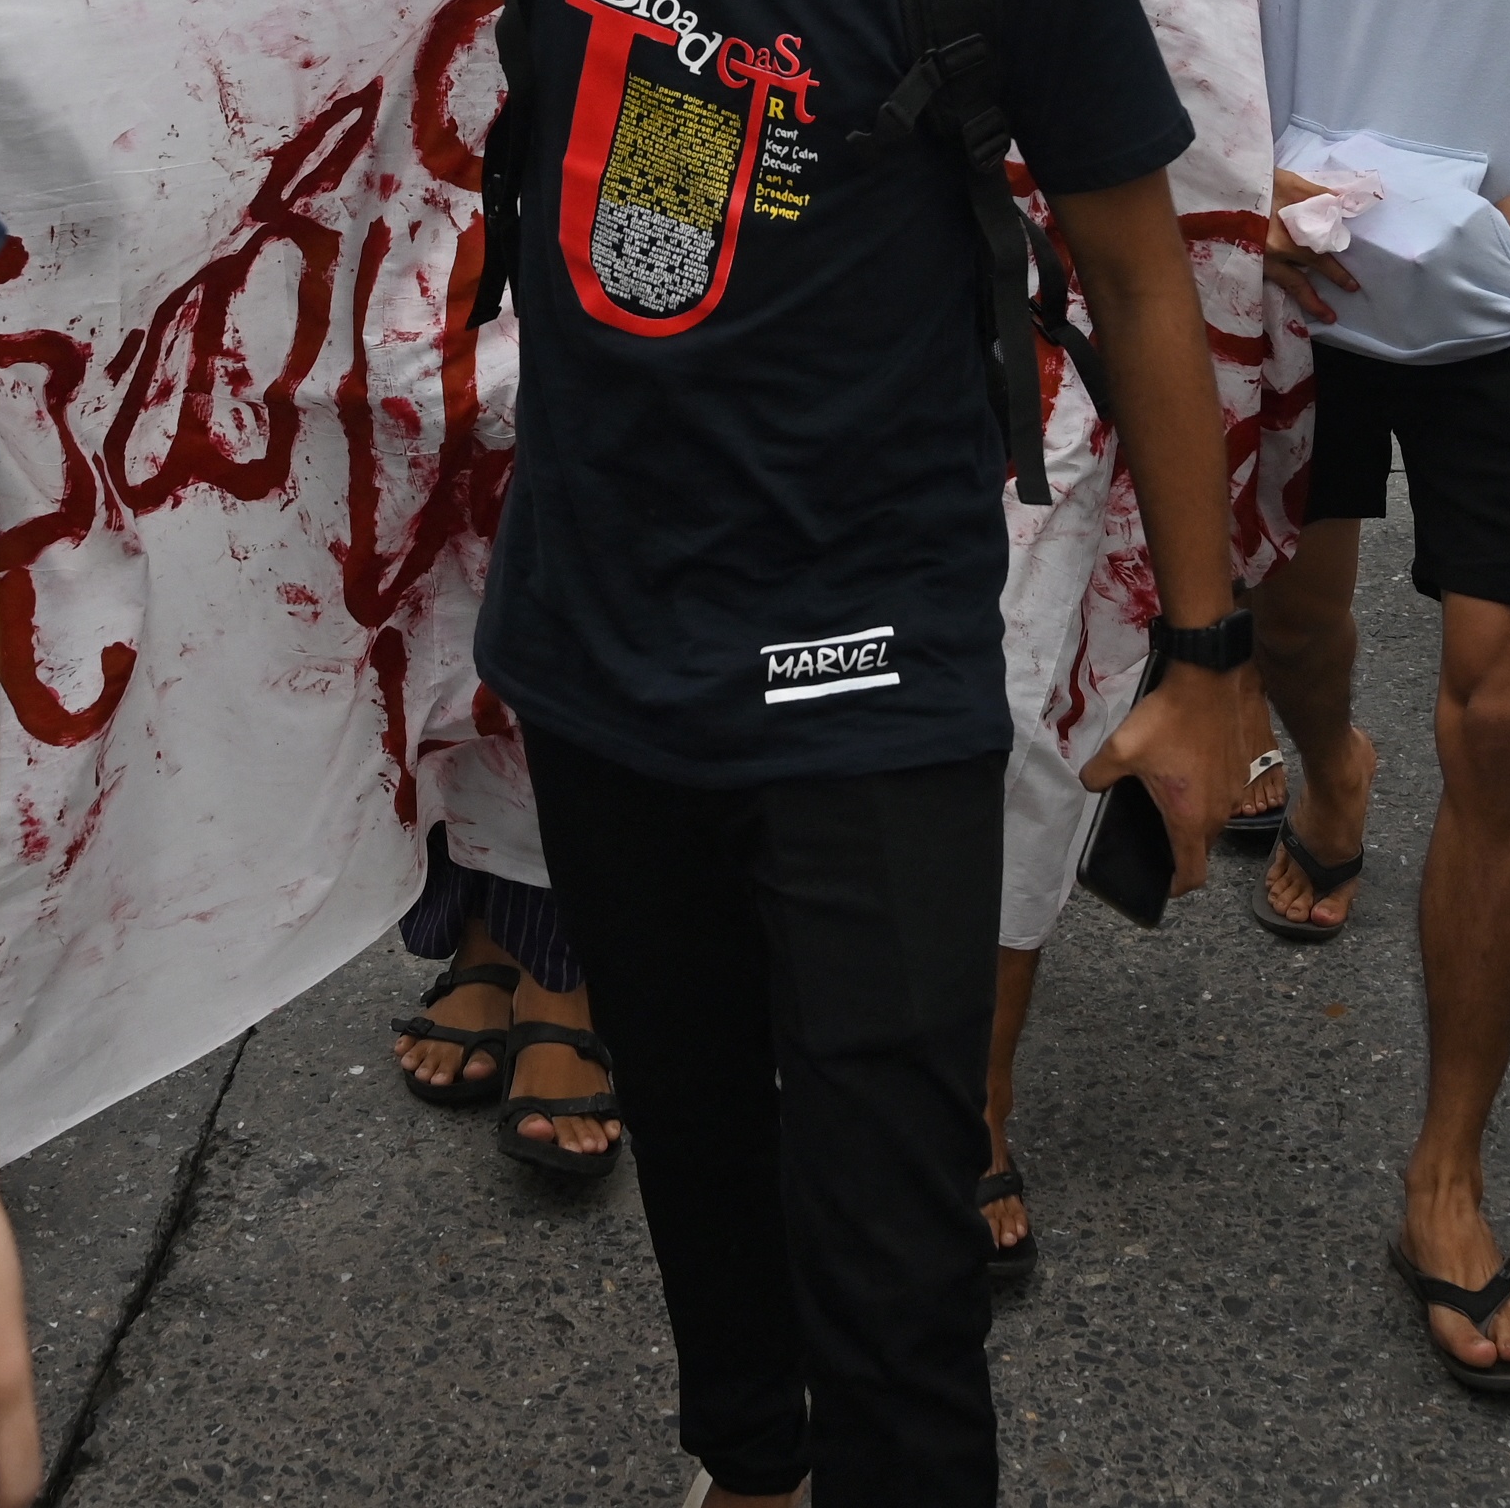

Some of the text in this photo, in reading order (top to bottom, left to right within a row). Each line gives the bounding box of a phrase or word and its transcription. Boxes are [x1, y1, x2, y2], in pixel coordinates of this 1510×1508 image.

[774, 127, 799, 141] cant
[761, 152, 802, 174] Because
[755, 182, 810, 206] Broadcast
[768, 641, 889, 682] MARVEL
